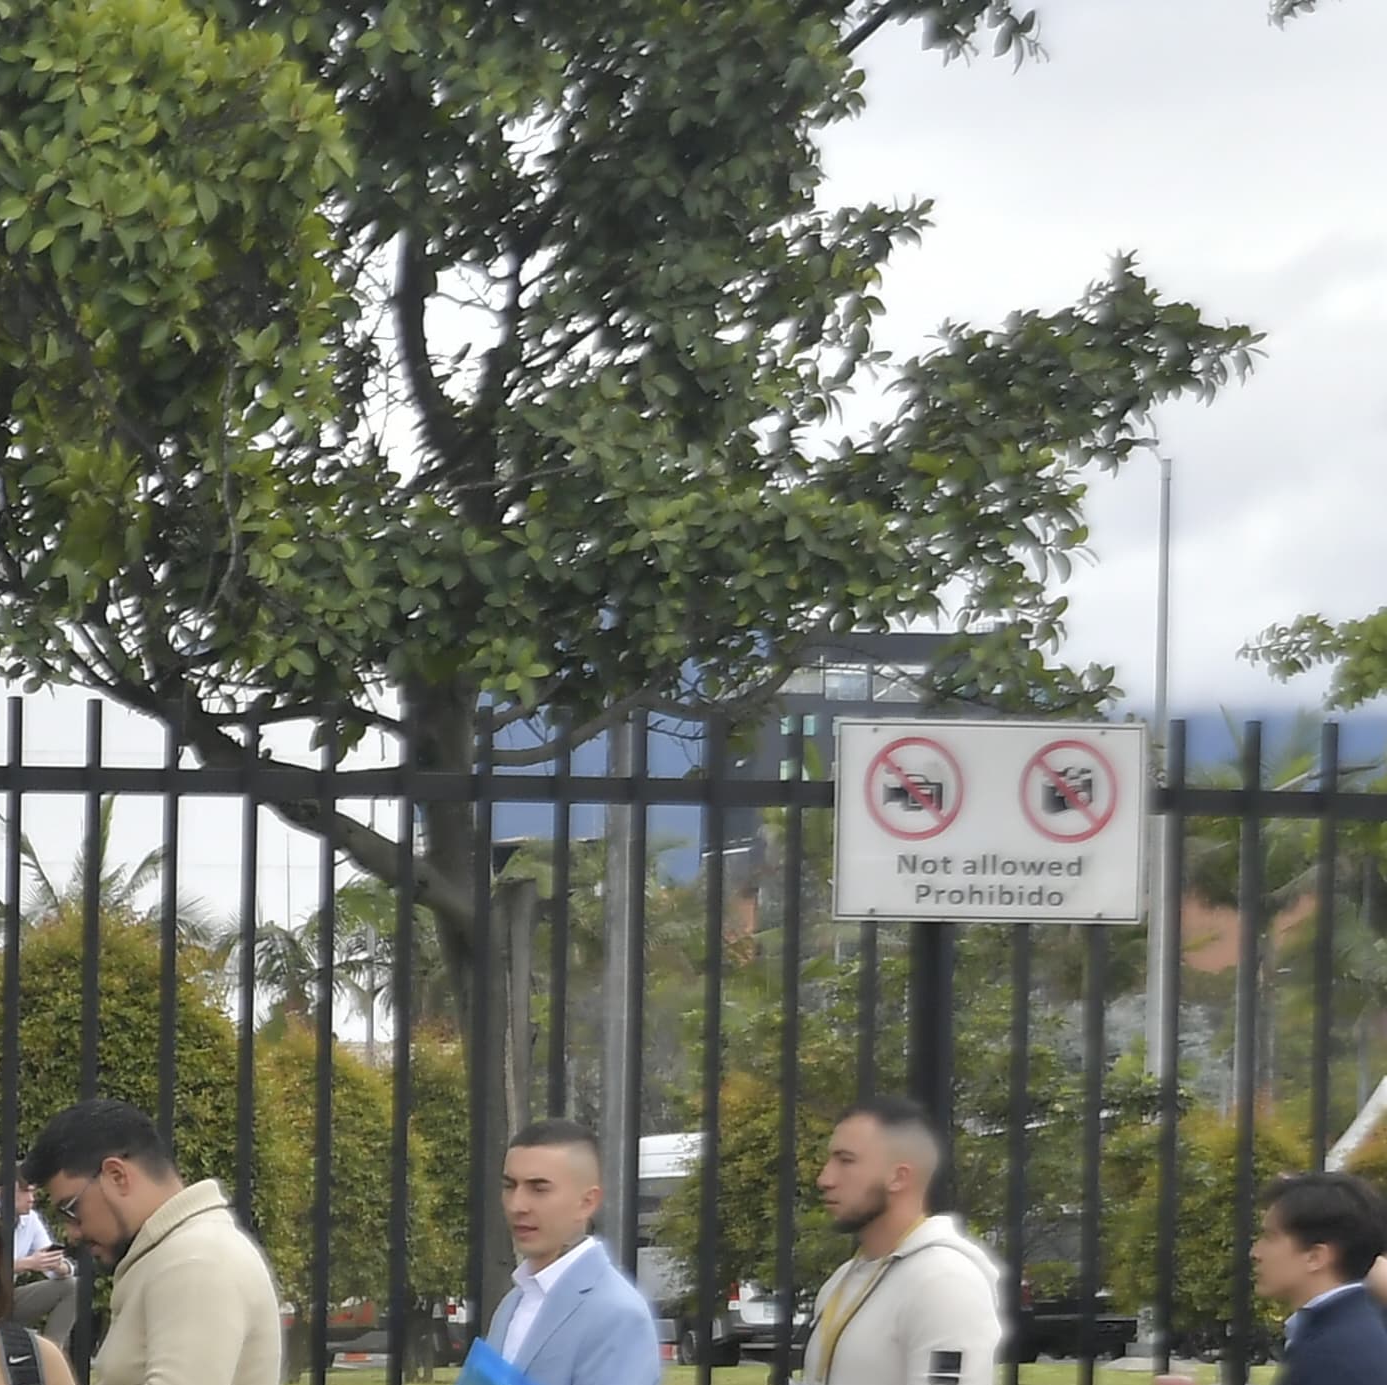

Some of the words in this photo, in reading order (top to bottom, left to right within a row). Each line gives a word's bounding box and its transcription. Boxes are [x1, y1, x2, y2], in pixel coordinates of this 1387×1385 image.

[897, 854, 953, 875] Not
[962, 854, 1083, 877] allowed
[915, 884, 1064, 907] Prohibido
